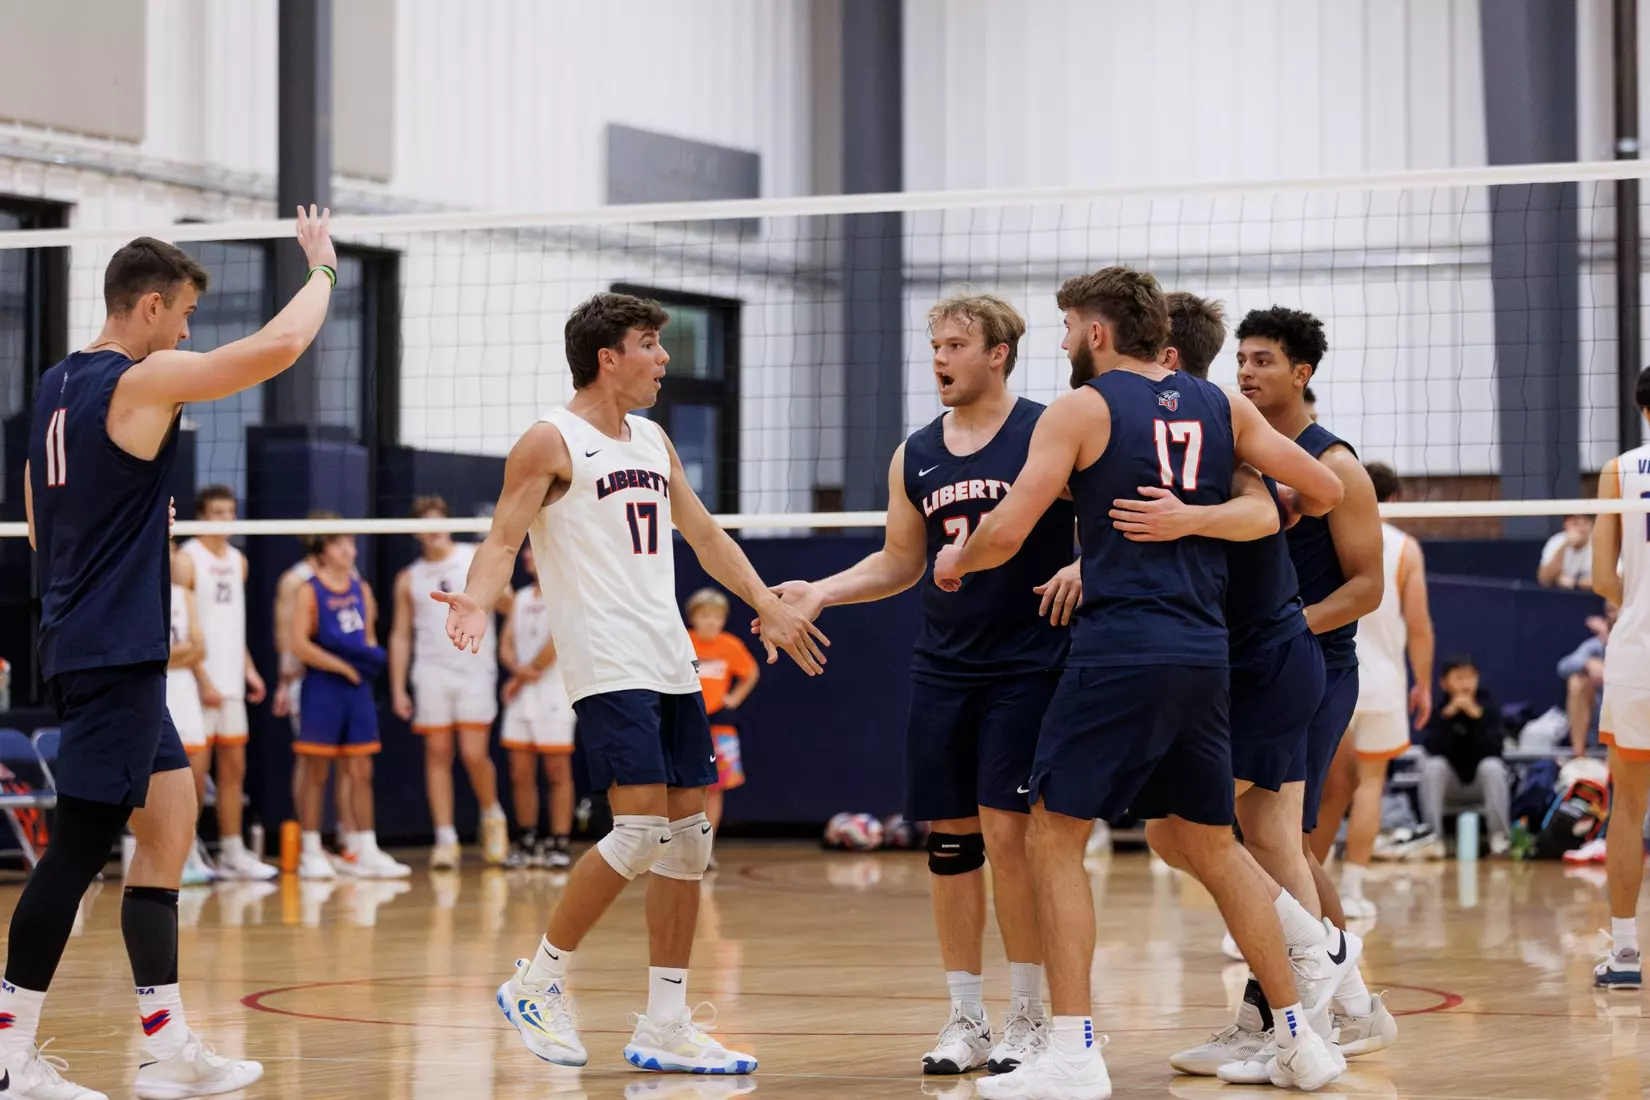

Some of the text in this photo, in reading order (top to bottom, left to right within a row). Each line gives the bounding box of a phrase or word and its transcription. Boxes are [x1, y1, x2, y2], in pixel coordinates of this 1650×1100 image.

[46, 408, 67, 487] 11
[1153, 418, 1204, 491] 17
[596, 469, 668, 500] LIBERTY
[626, 502, 657, 554] 17
